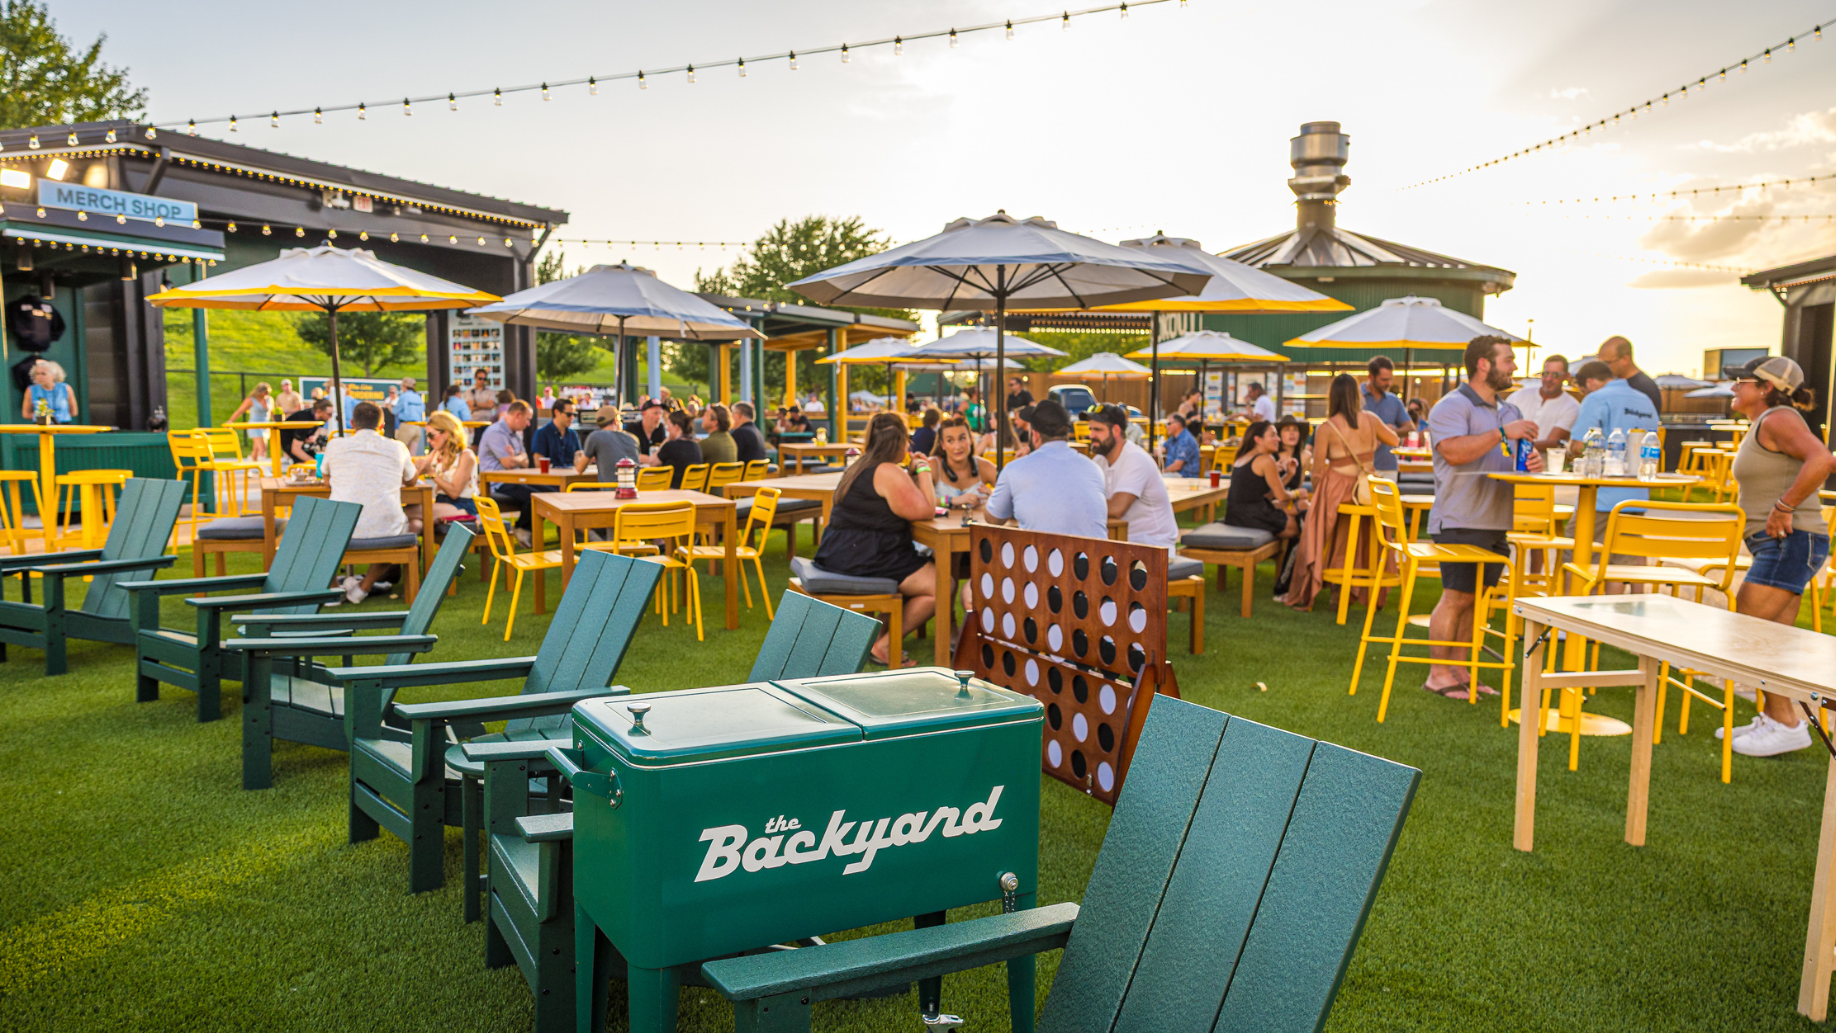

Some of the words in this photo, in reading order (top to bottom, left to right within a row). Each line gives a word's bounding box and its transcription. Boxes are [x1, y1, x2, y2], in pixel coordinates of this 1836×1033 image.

[56, 187, 126, 211] MERCH
[131, 199, 182, 219] SHOP
[694, 785, 1005, 882] Backyard
[765, 814, 802, 834] the
